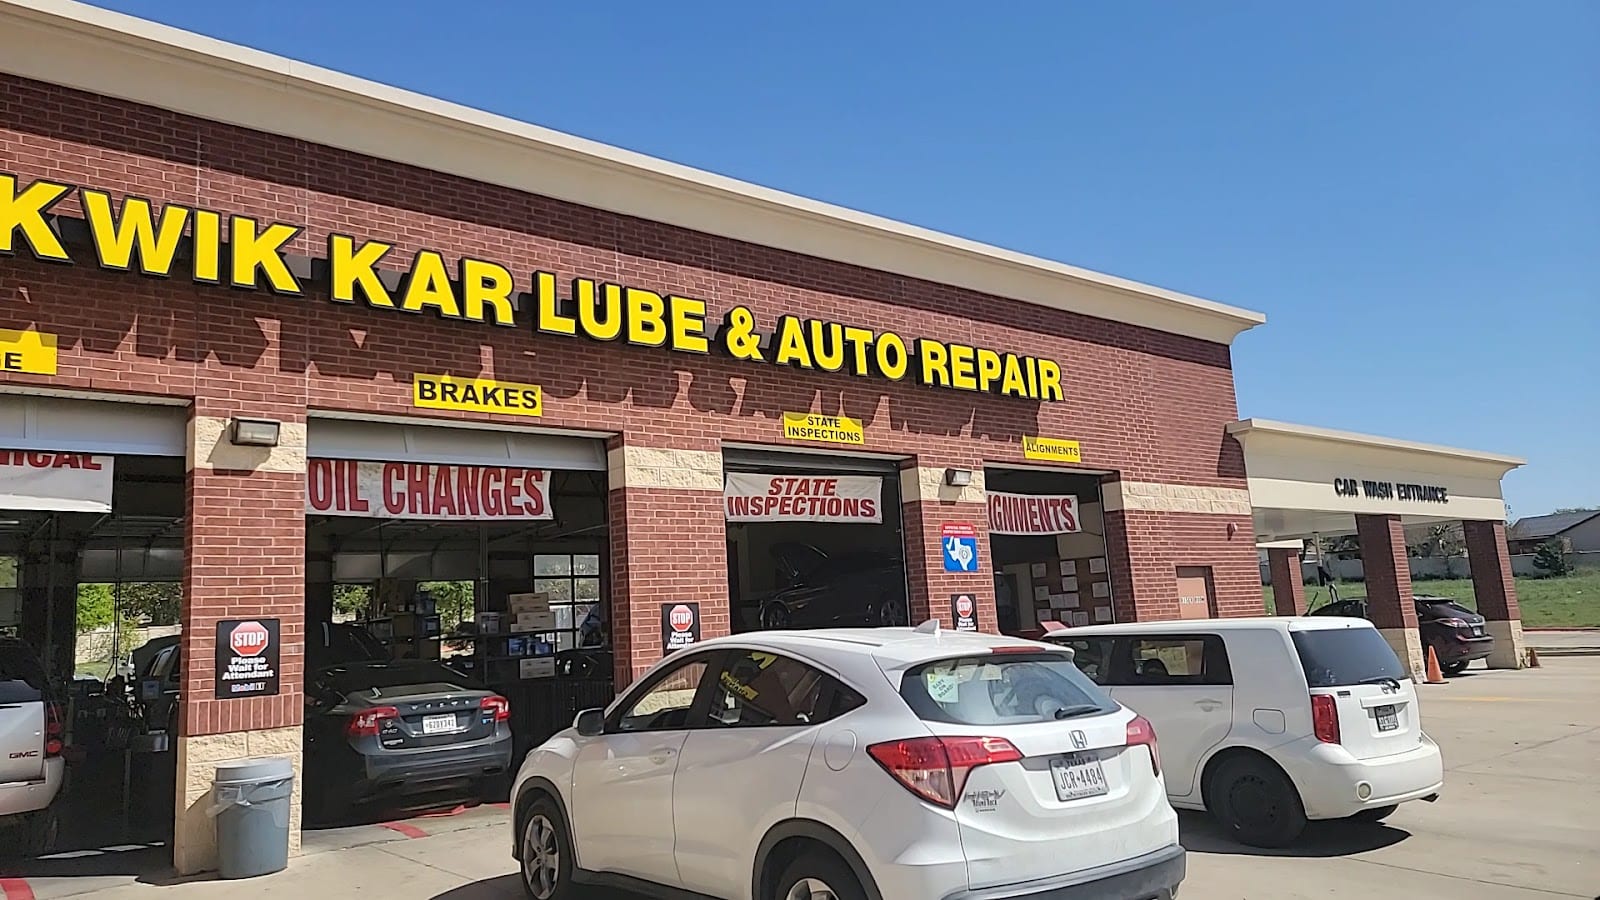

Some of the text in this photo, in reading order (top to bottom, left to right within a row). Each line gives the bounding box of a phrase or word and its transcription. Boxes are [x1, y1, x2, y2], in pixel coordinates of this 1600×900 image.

[330, 233, 515, 326] KAR
[537, 271, 709, 353] LUBE
[724, 306, 763, 361] &
[775, 314, 909, 382] AUTO
[918, 339, 1064, 401] REPAIR
[418, 380, 538, 409] BRAKES
[807, 416, 841, 428] STATE
[787, 426, 861, 442] INSPECTIONS
[1026, 443, 1079, 456] ALIGNMENTS
[308, 458, 544, 516] OIL CHANGES
[768, 478, 838, 496] STATE
[1334, 478, 1448, 503] CAR WASH ENTRANCE
[727, 496, 876, 517] INSPECTIONS
[988, 494, 1077, 532] IGNMENTS
[234, 632, 264, 646] STOP
[222, 670, 274, 680] Attendant
[228, 664, 252, 672] Wait
[9, 750, 39, 759] GMC
